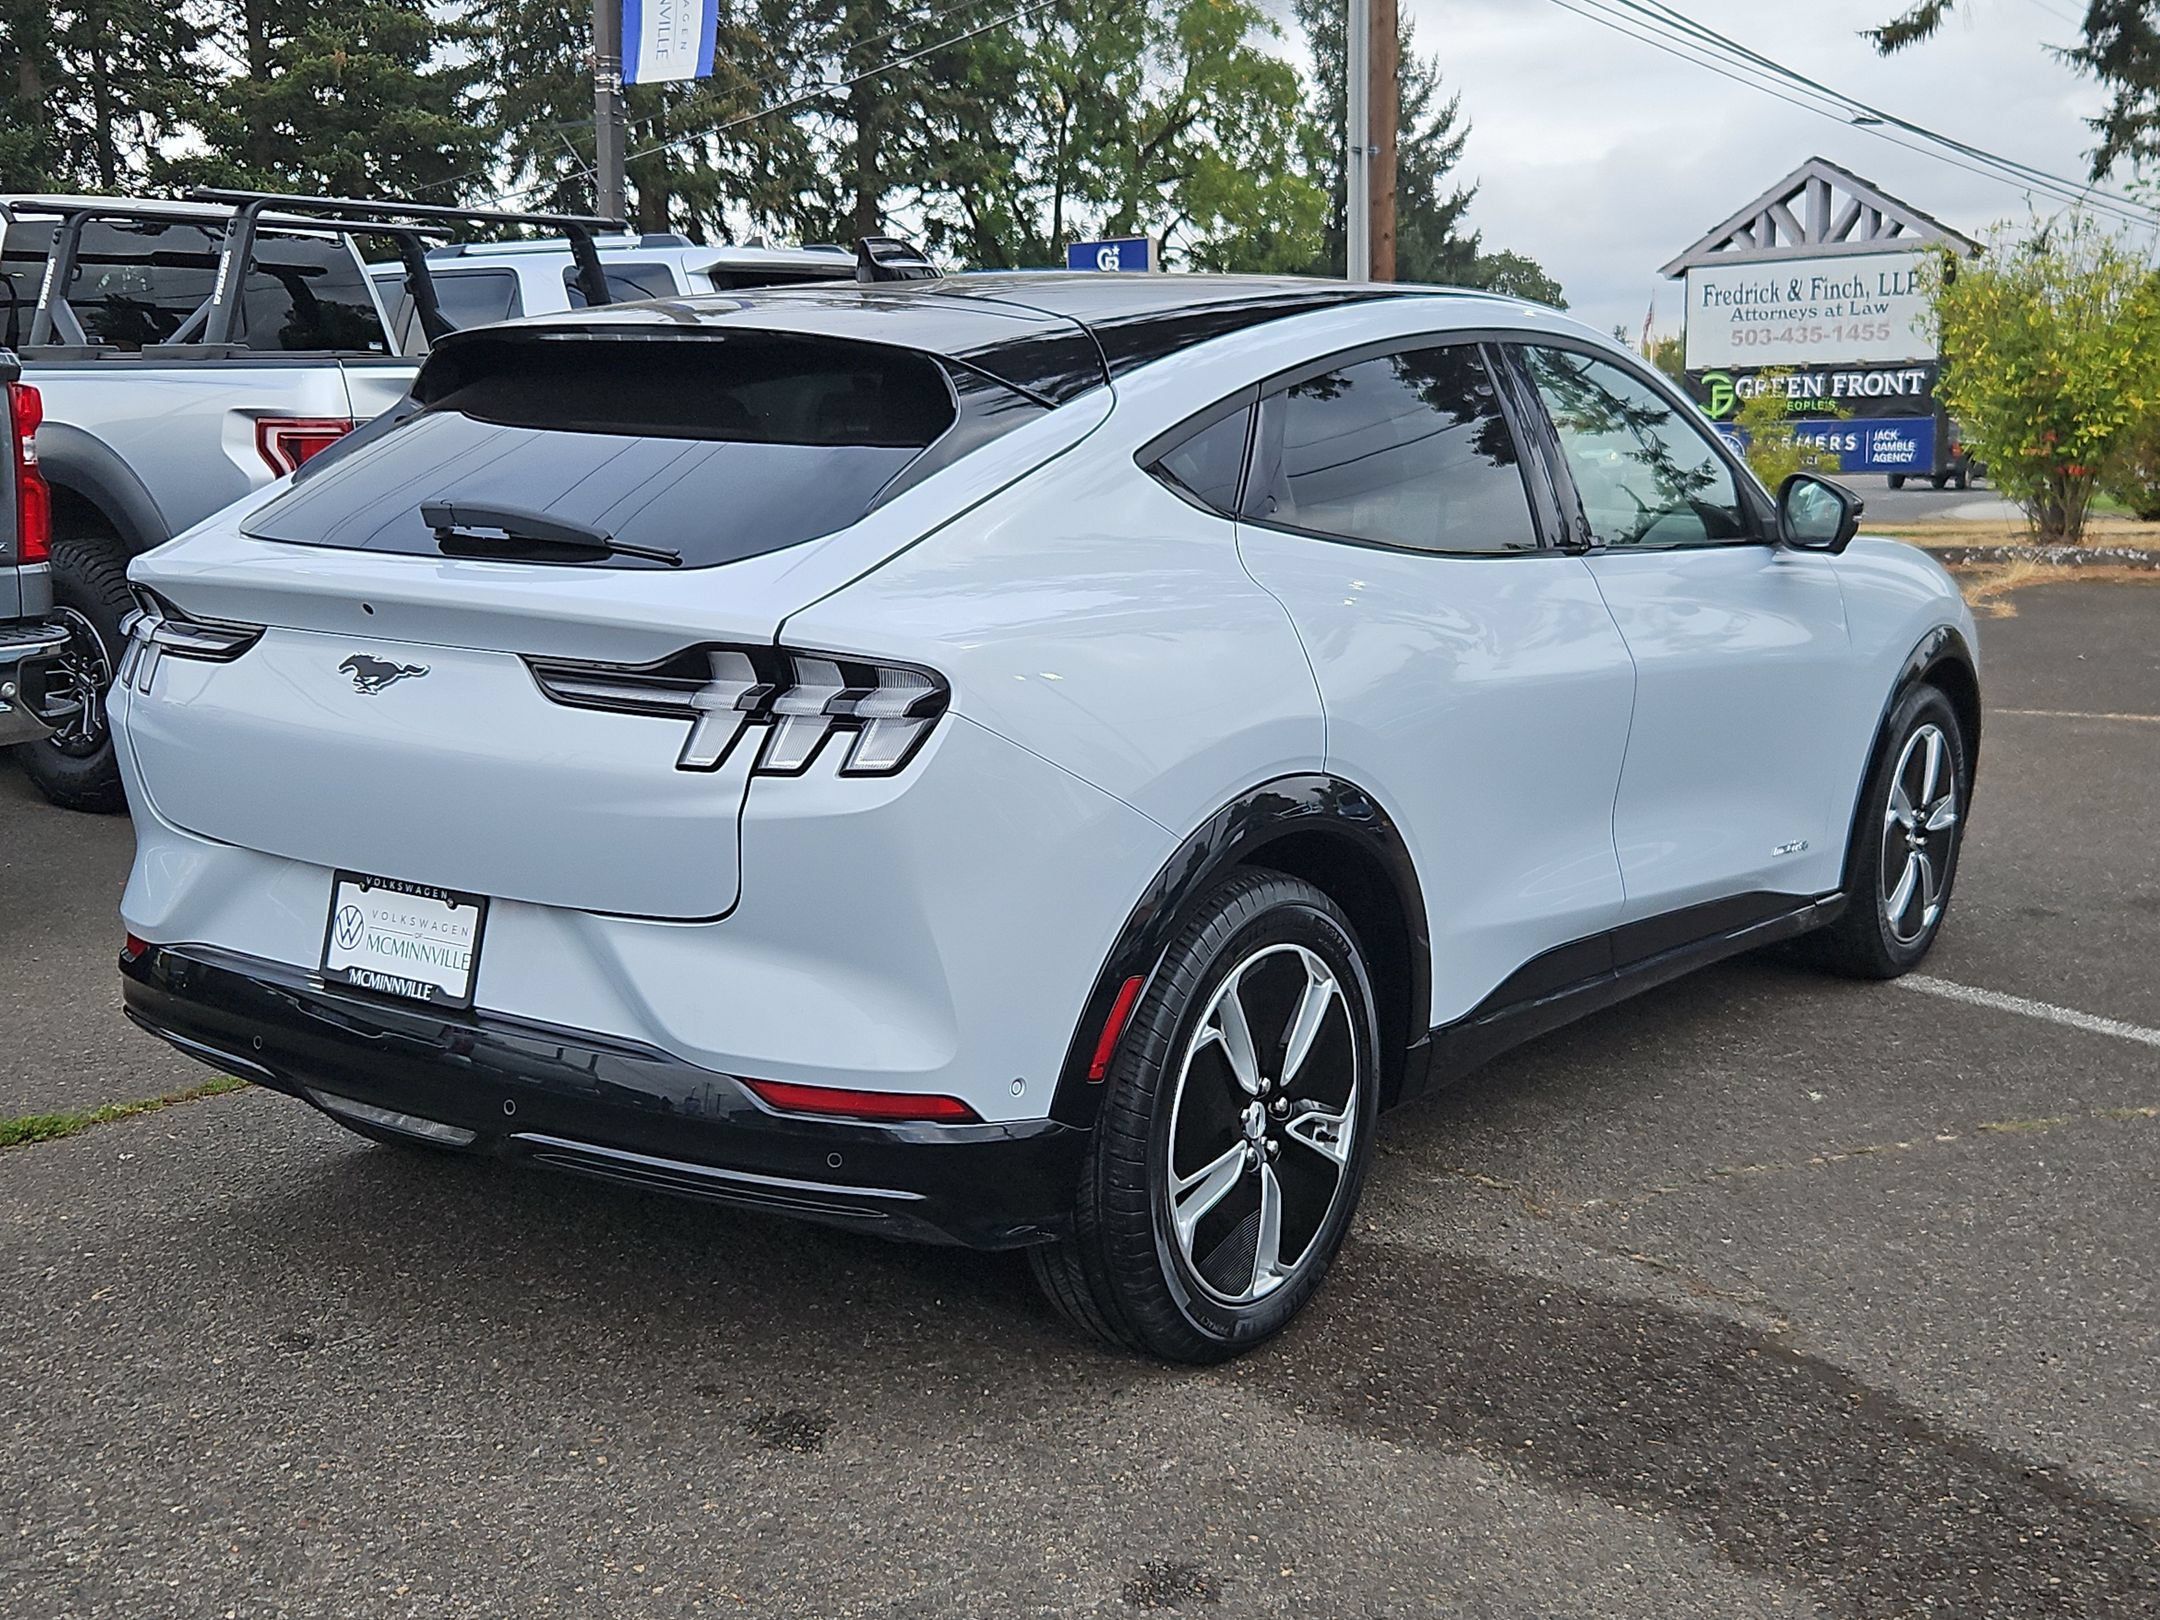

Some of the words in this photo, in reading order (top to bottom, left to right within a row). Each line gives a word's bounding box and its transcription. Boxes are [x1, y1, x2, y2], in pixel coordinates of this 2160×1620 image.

[1703, 278, 1780, 307] Fredrick
[1787, 278, 1802, 302] &
[1810, 274, 1870, 301] Finch,
[1730, 303, 1818, 322] Attorneys
[1825, 303, 1843, 317] at
[1850, 301, 1889, 316] Law
[1731, 323, 1891, 347] 503-435-1455
[1831, 369, 1925, 397] FRONT
[1786, 399, 1836, 411] EOPLE'S
[1873, 430, 1898, 441] JACK
[1873, 440, 1916, 452] GAMBLE
[1872, 452, 1914, 463] AGENCY
[366, 876, 448, 899] VOLKSWAGEN
[372, 910, 469, 937] VOLKSWAGEN
[366, 934, 472, 971] MCMINNVILLE
[349, 968, 433, 1001] MCMINNVILLE
